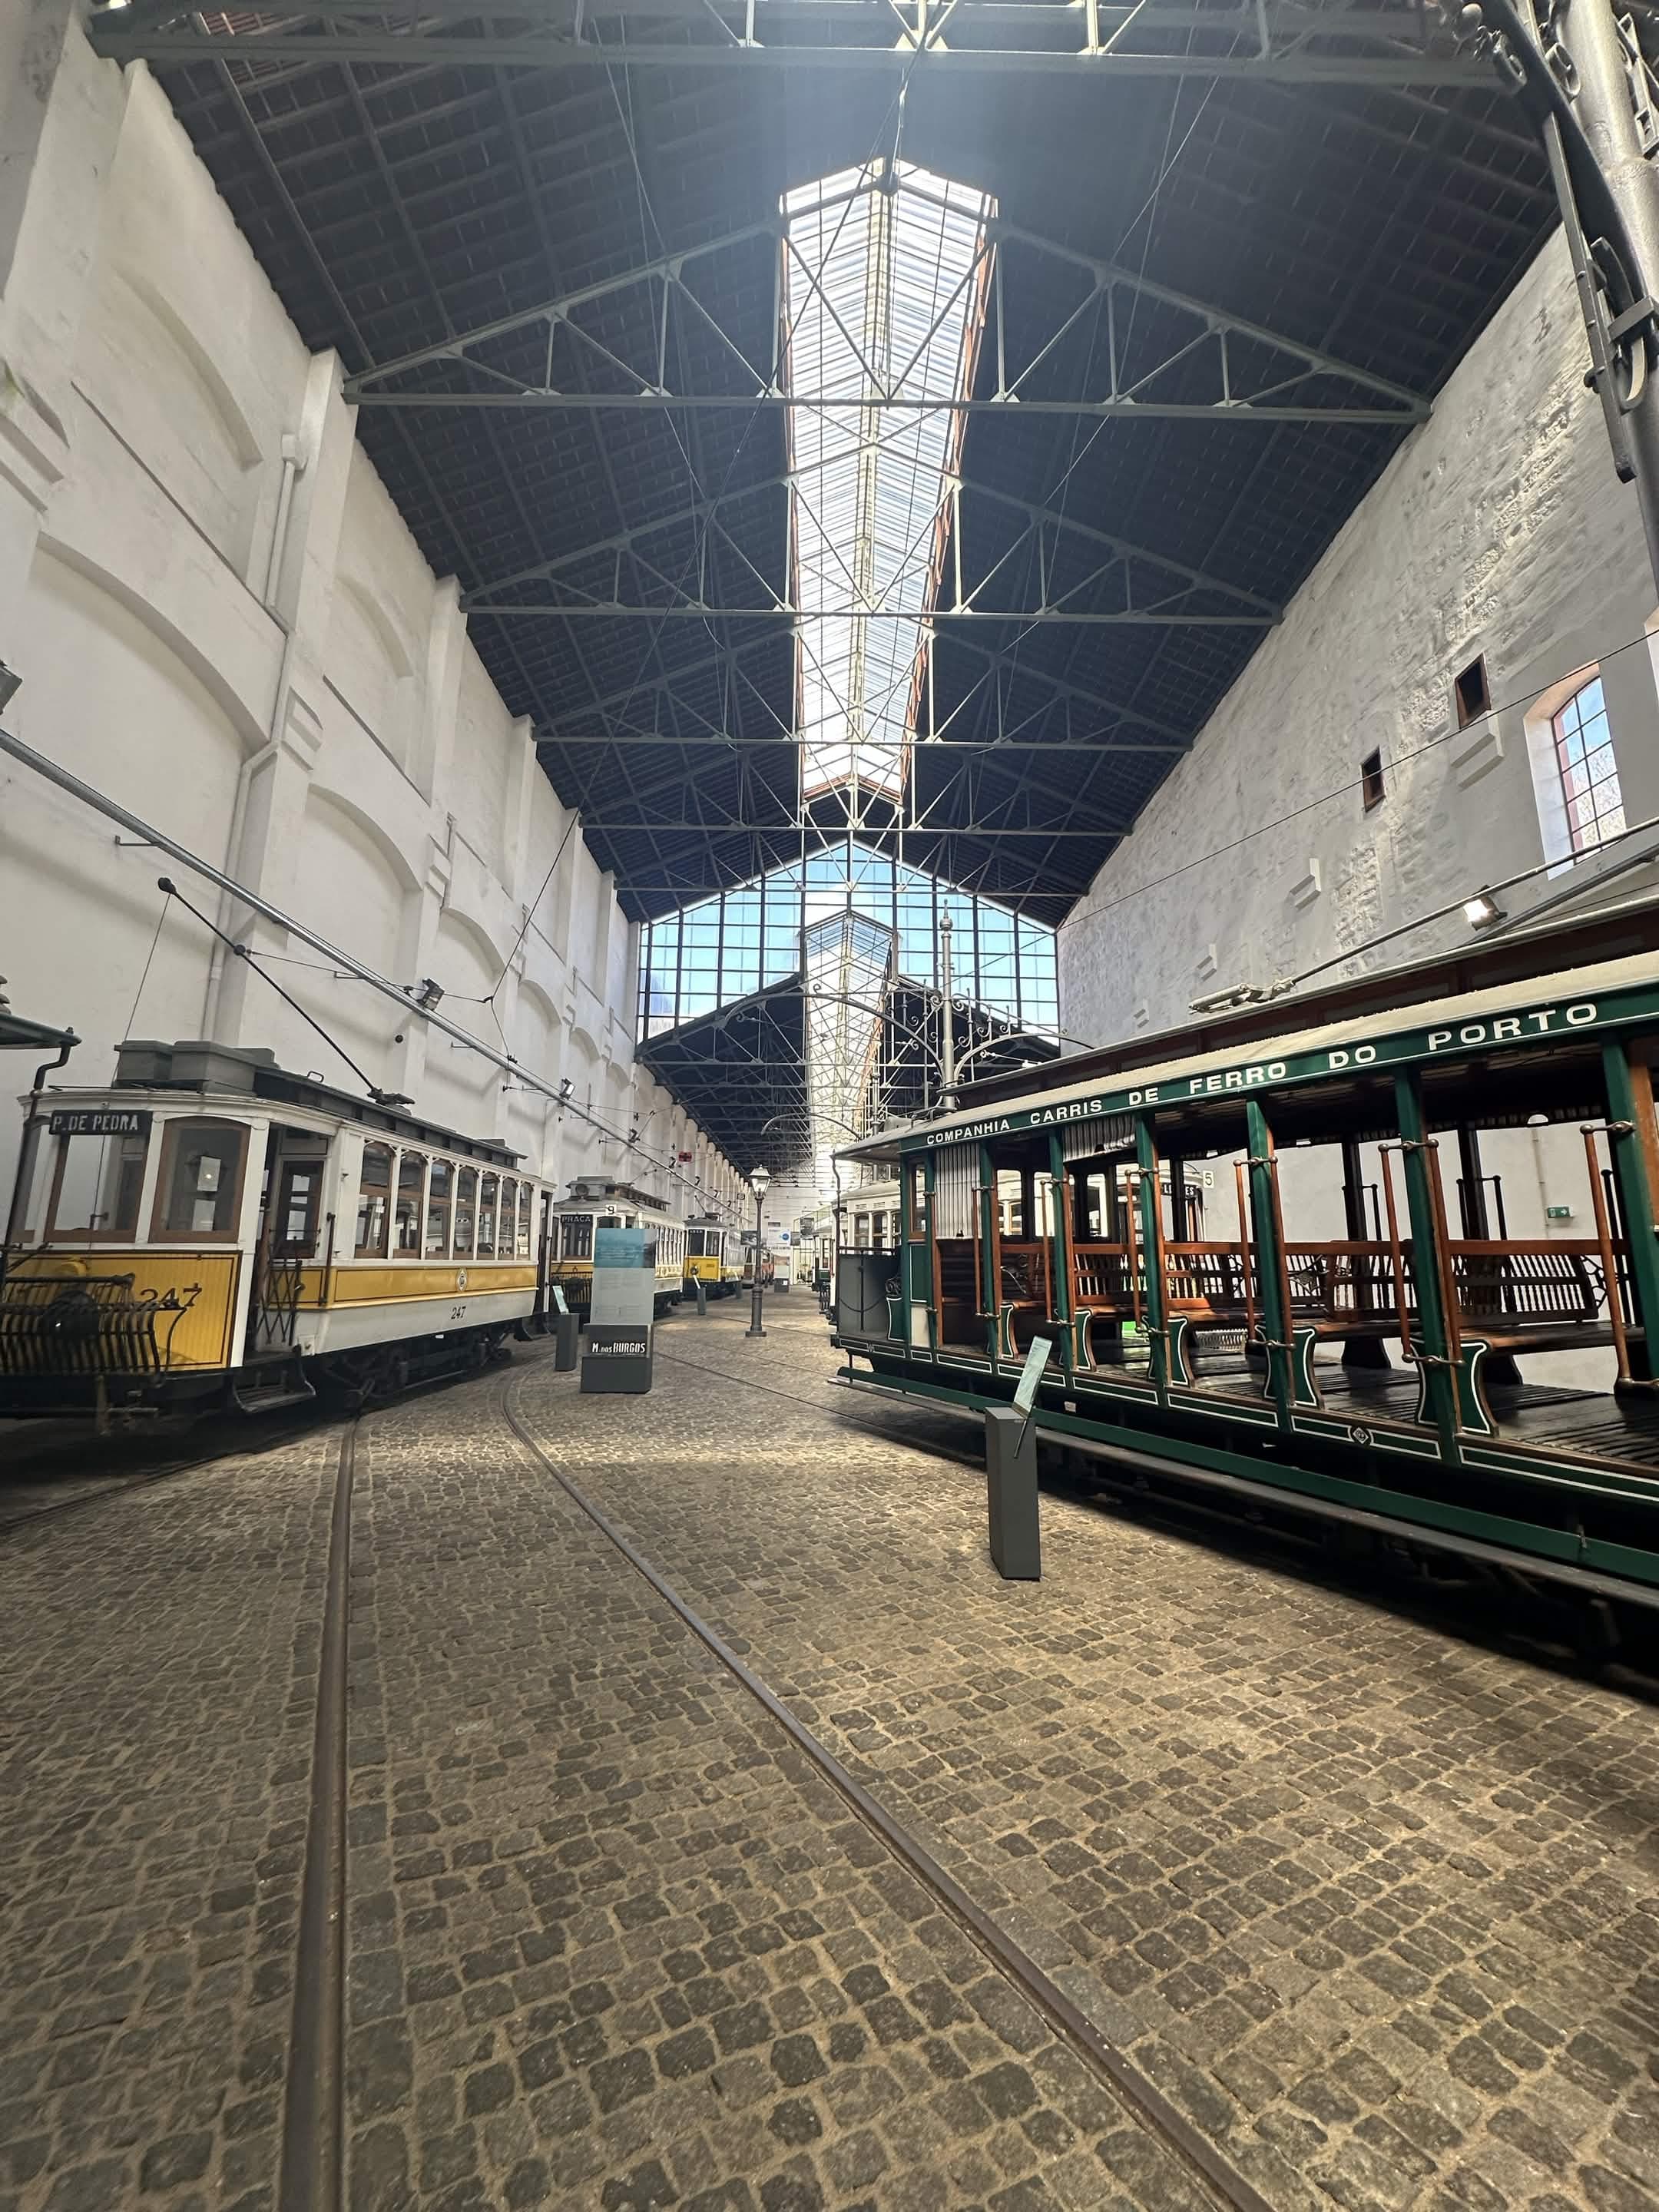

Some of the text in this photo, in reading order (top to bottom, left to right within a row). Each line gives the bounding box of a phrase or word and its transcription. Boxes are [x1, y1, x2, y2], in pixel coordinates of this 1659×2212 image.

[926, 1003, 1598, 1144] COMPANHIA CARRIS DE FERRO DO PORTO
[92, 1114, 138, 1131] PEDRA
[1205, 1173, 1213, 1186] 5
[607, 1205, 615, 1215] 9
[138, 1283, 203, 1307] 247
[450, 1306, 467, 1320] 247
[613, 1342, 646, 1353] BURGOS
